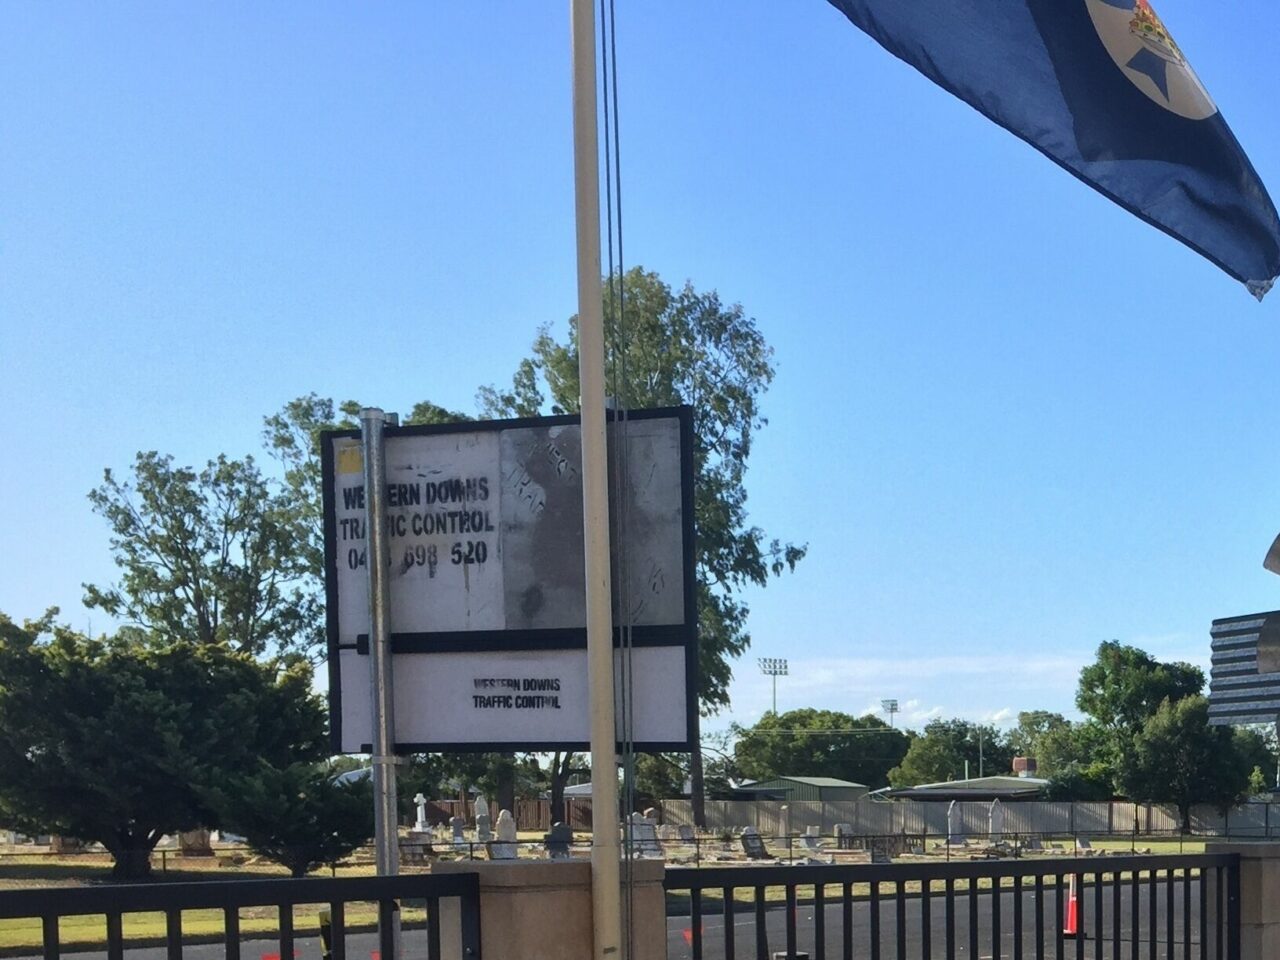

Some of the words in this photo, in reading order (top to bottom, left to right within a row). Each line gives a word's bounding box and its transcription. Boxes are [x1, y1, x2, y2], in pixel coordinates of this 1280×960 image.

[343, 483, 420, 510] WEERN
[426, 477, 489, 504] DOWNS
[340, 514, 406, 540] TRIC
[411, 511, 494, 537] CONTROL
[522, 678, 560, 691] DOWNS
[472, 695, 512, 708] TRAFFIC
